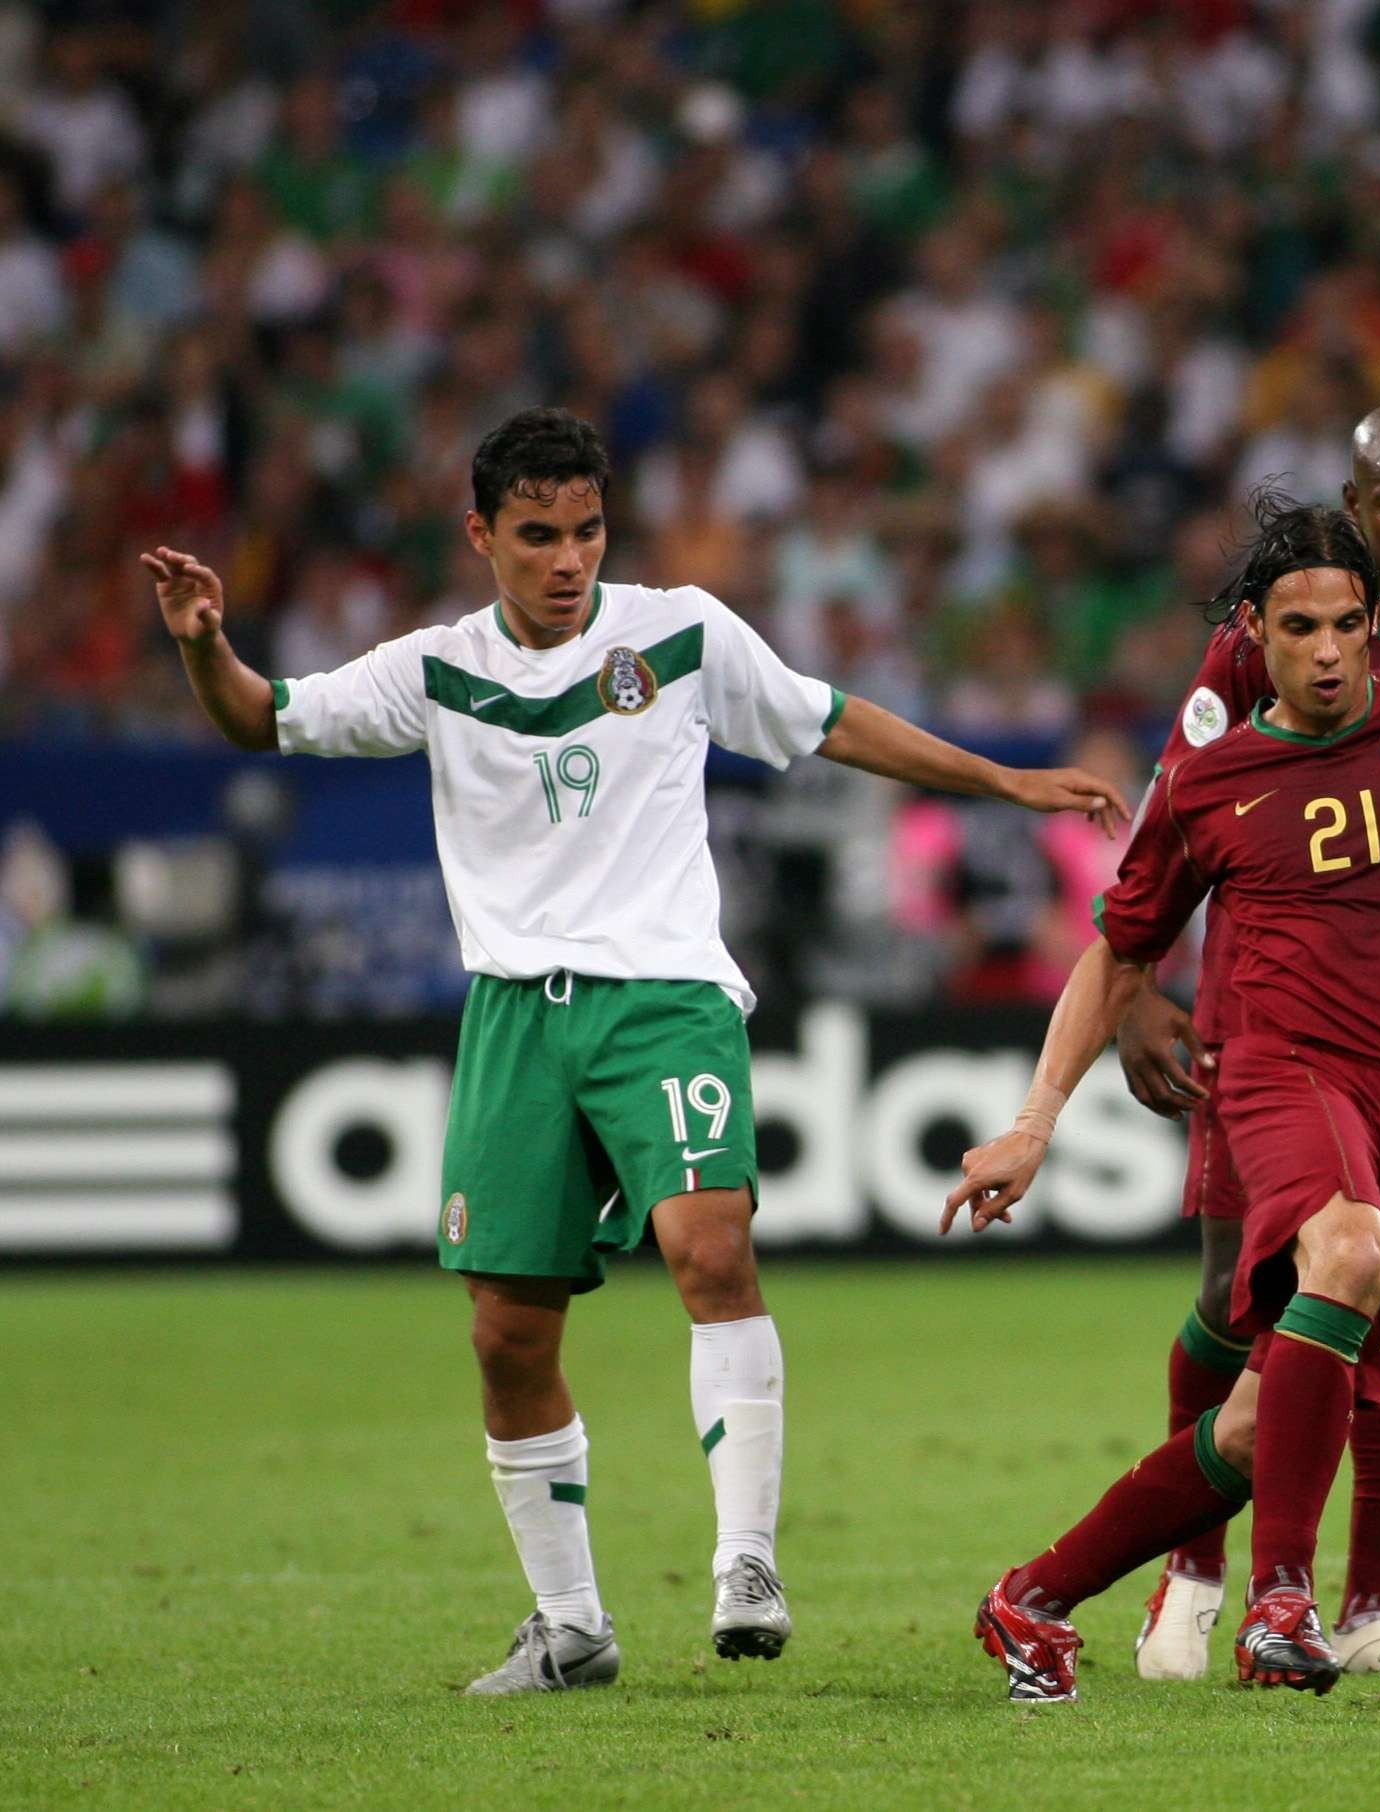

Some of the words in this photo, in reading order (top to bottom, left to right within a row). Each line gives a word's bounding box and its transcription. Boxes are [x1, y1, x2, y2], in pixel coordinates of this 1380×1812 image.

[533, 745, 600, 823] 19
[1304, 789, 1380, 873] 21
[272, 1003, 1192, 1246] adas
[661, 1073, 731, 1142] 19
